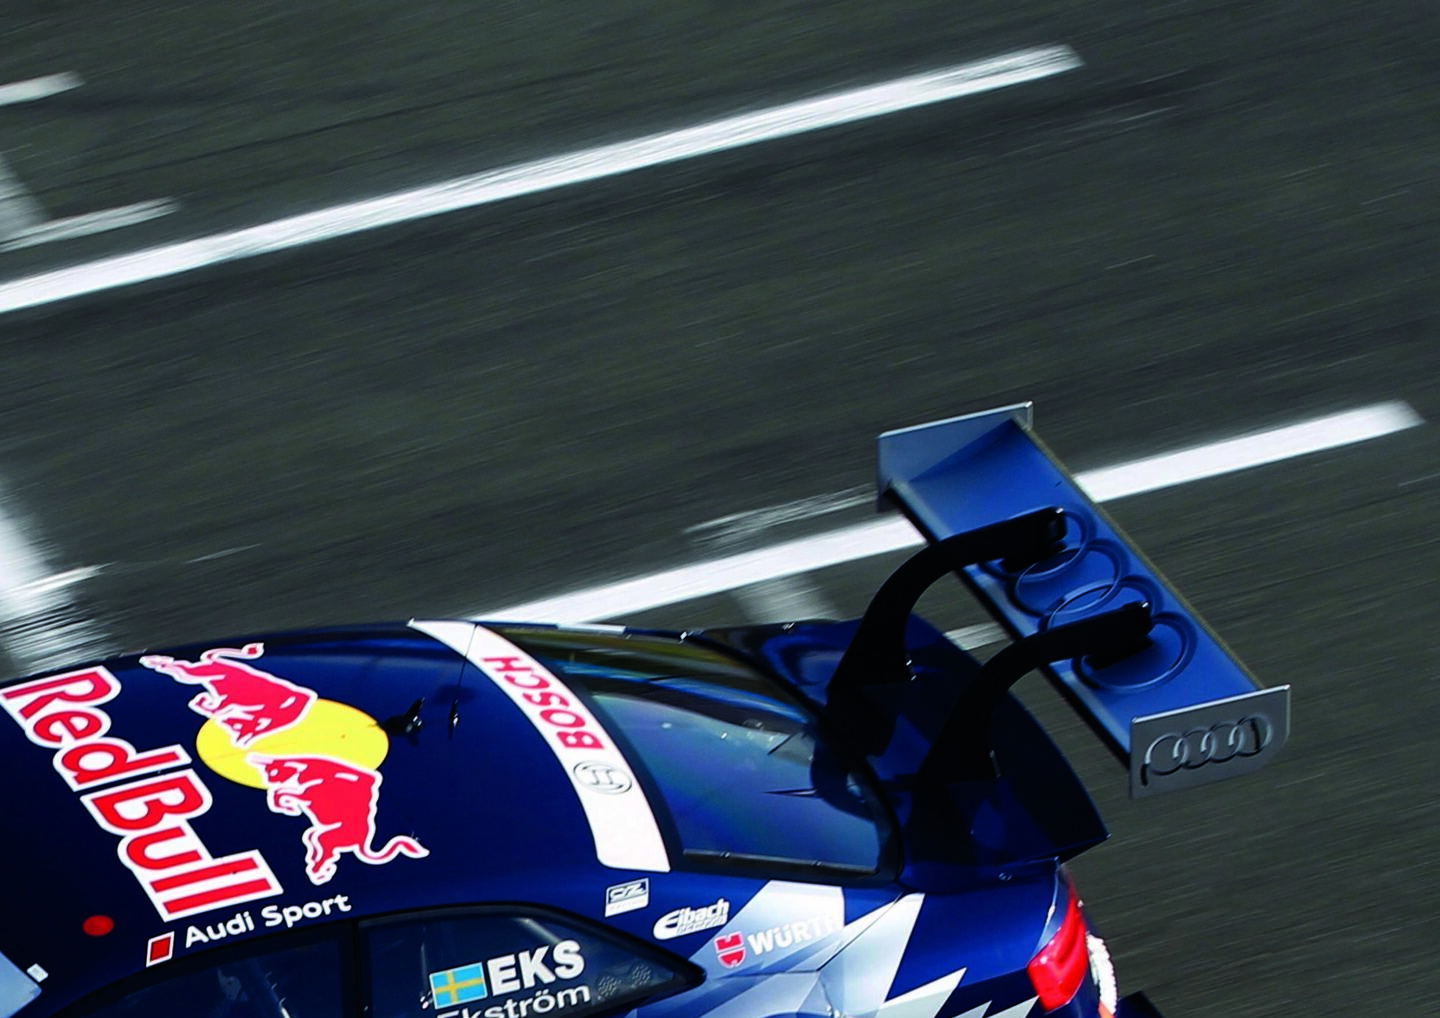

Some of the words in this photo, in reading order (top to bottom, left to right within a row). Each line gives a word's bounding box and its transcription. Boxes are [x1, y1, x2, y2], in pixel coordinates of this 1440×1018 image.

[482, 656, 605, 750] BOSCH
[82, 769, 282, 920] Bull
[185, 911, 255, 949] Audi
[261, 894, 352, 928] Sport
[487, 940, 586, 997] EKS
